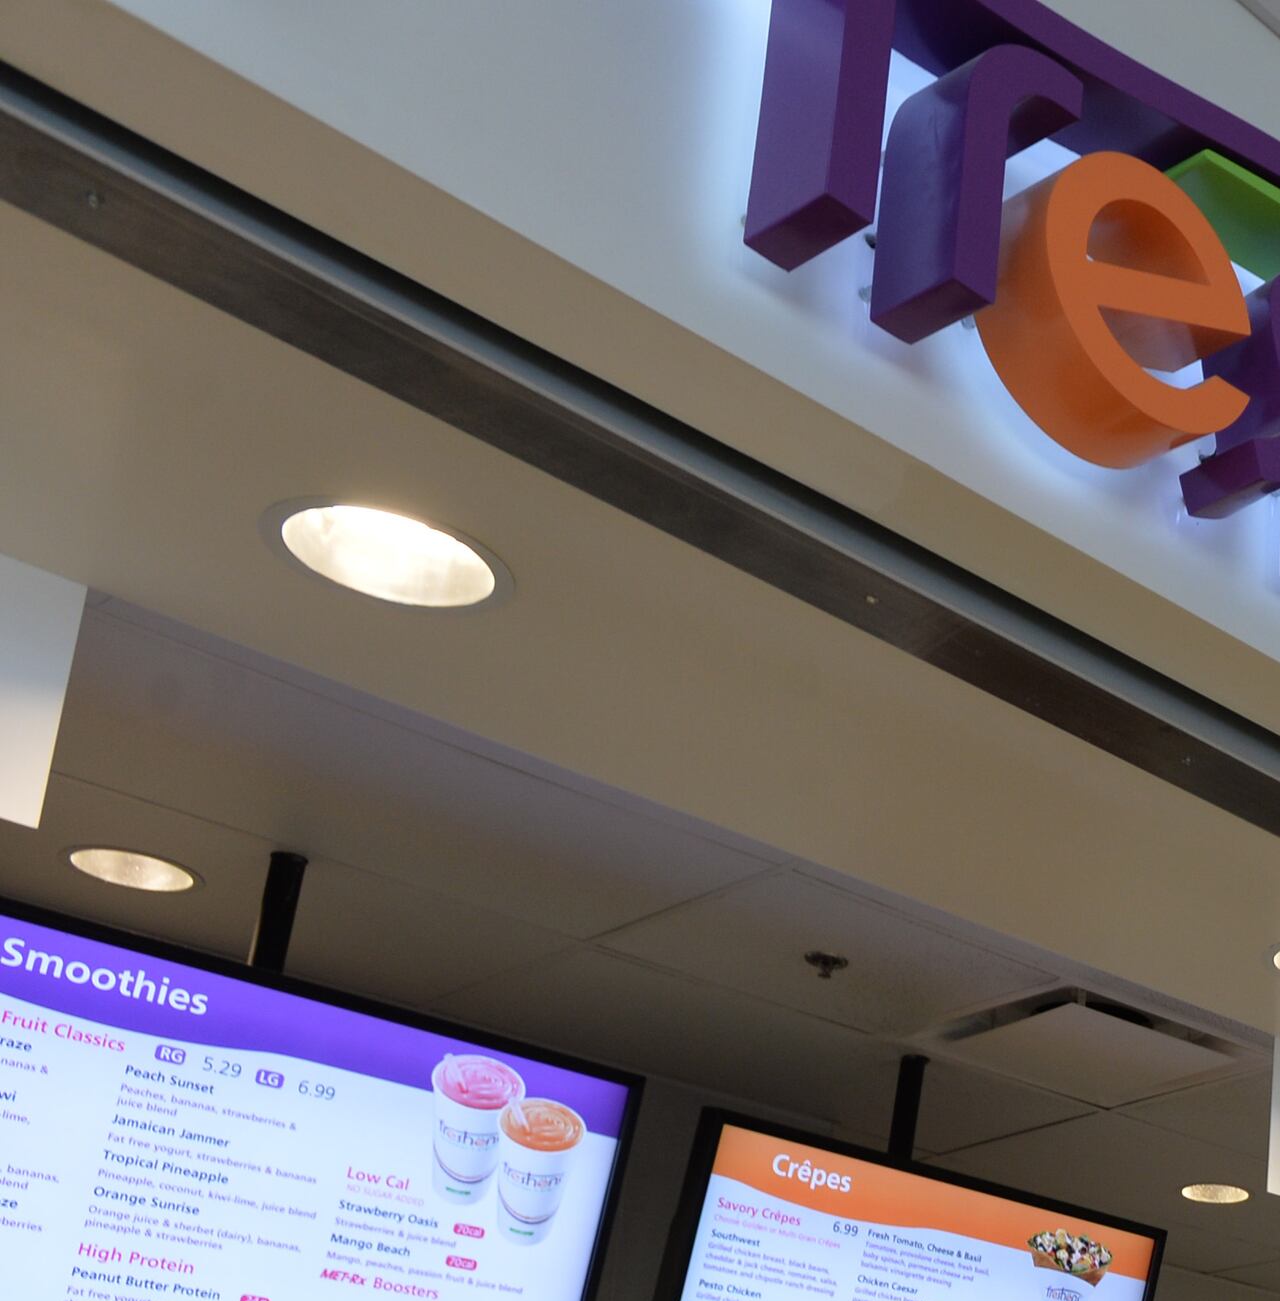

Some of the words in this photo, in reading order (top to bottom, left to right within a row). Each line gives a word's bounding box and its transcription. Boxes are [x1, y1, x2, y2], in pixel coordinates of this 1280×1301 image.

[1, 936, 209, 1016] Smoothies
[1, 1010, 48, 1033] Fruit
[54, 1023, 125, 1051] Classics
[125, 1064, 165, 1083] Peach
[170, 1075, 214, 1094] Sunset
[160, 1046, 185, 1065] RG
[202, 1056, 242, 1078] 5.29
[298, 1080, 336, 1100] 6.99
[107, 1131, 125, 1144] Fat
[128, 1136, 150, 1149] free
[113, 1114, 175, 1136] Jamaican
[181, 1129, 228, 1147] Jammer
[102, 1149, 158, 1170] Tropical
[161, 1161, 228, 1184] Pineapple
[346, 1166, 381, 1184] Low
[385, 1175, 409, 1190] Cal
[773, 1153, 852, 1192] Crêpes
[87, 1204, 130, 1221] Orange
[93, 1186, 146, 1206] Orange
[151, 1197, 200, 1215] Sunrise
[338, 1199, 403, 1223] Strawberry
[407, 1214, 438, 1228] Oasis
[717, 1197, 758, 1218] Savory
[832, 1220, 859, 1237] 6.99
[78, 1242, 122, 1262] High
[128, 1251, 194, 1274] Protein
[330, 1233, 373, 1250] Mango
[376, 1242, 411, 1256] Beach
[66, 1285, 84, 1296] Fat
[71, 1266, 121, 1284] Peanut
[125, 1275, 169, 1291] Butter
[172, 1283, 221, 1300] Protein
[373, 1277, 439, 1298] Boosters
[726, 1284, 762, 1298] Chicken
[857, 1274, 890, 1288] Chicken
